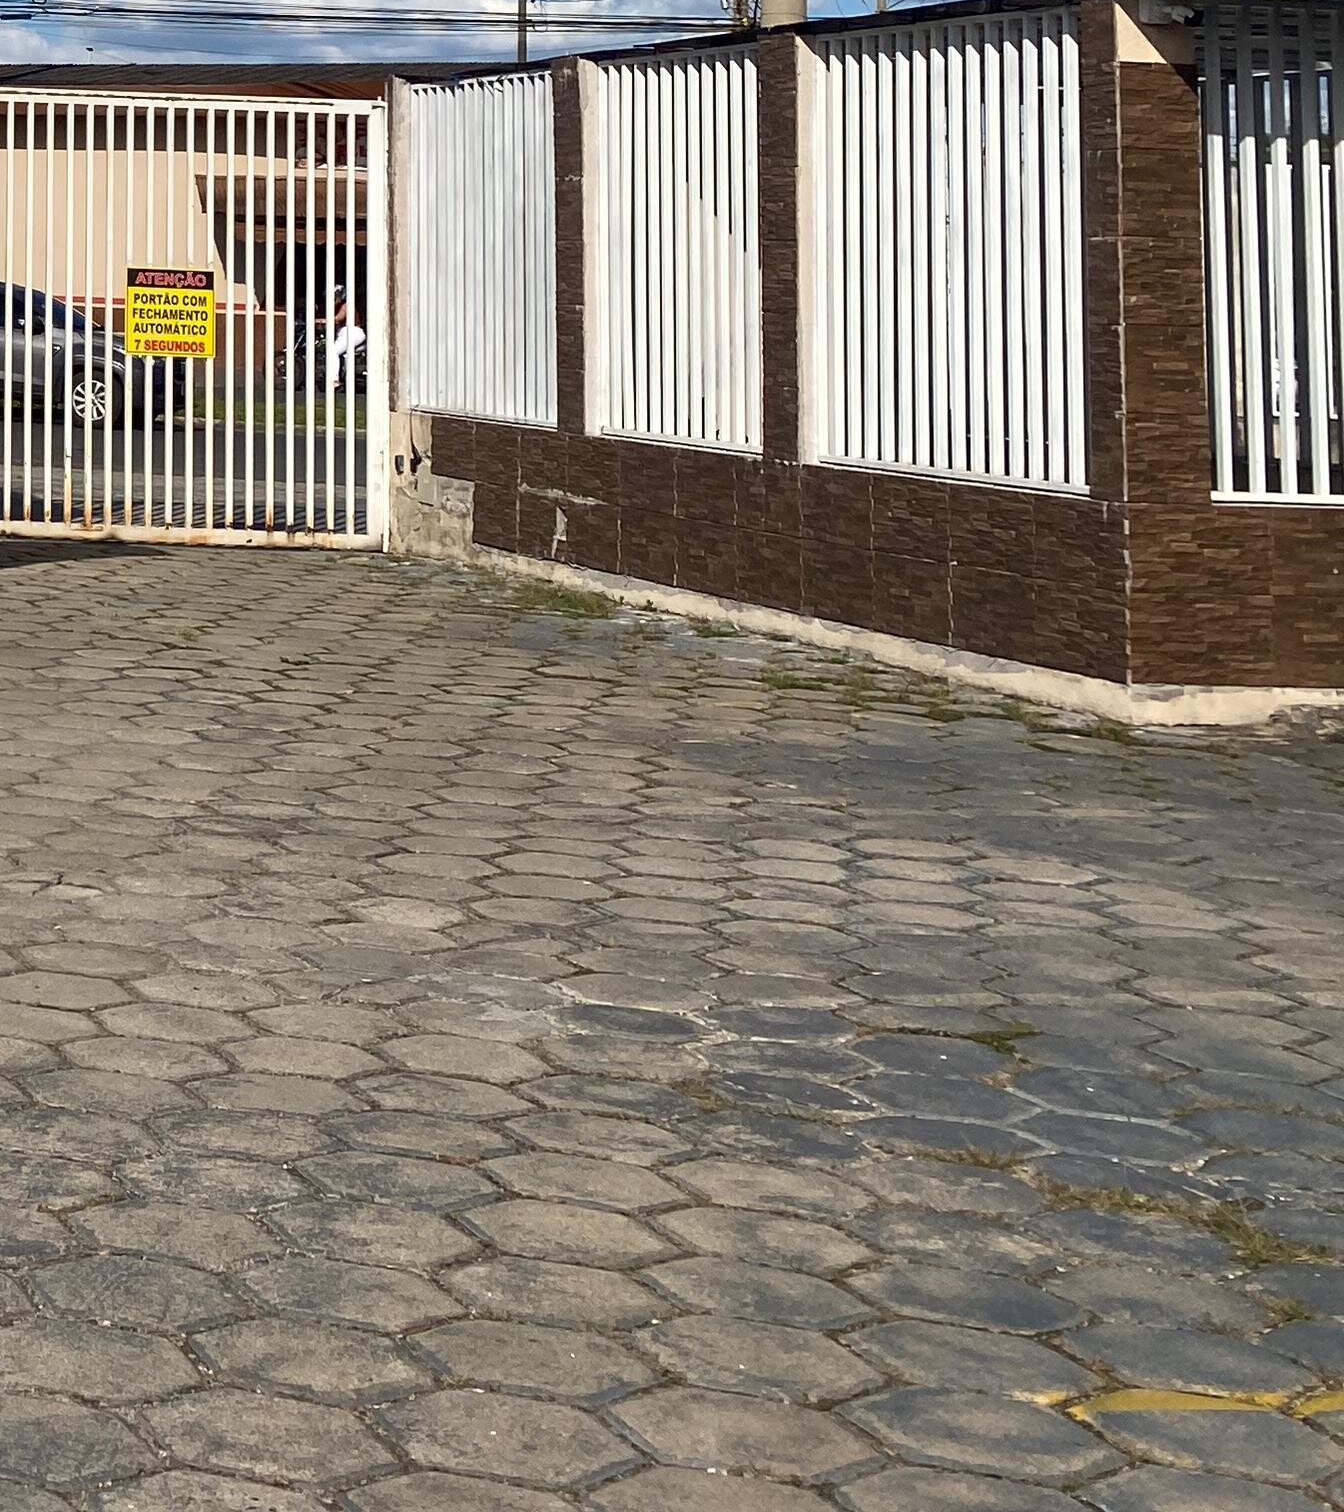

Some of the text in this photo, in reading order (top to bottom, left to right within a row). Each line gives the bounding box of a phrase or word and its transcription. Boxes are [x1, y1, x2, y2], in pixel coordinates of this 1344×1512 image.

[134, 271, 207, 288] ATENÇÃO
[133, 292, 208, 307] PORTÃO COM
[132, 307, 209, 322] FECHAMENTO
[132, 322, 207, 336] AUTOMÁTICO
[134, 339, 206, 353] 7 SEGUNDOS
